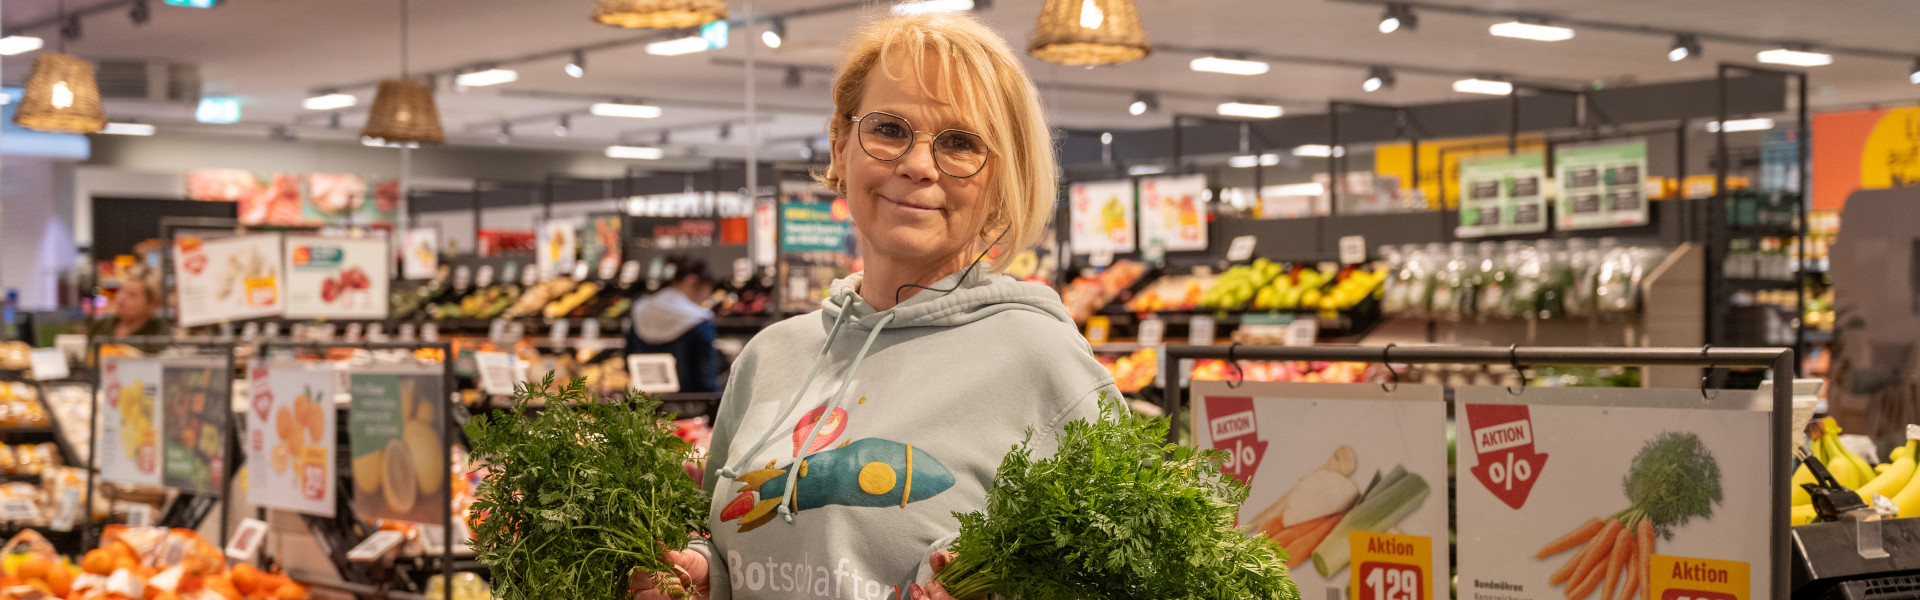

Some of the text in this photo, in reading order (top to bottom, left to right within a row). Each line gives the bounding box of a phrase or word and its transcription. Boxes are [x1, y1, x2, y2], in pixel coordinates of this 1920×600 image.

[1216, 414, 1251, 434] AKTION
[1481, 424, 1525, 448] AKTION
[1367, 536, 1414, 557] Aktion
[1671, 560, 1729, 584] Aktion
[1474, 579, 1523, 592] Bundmöhren
